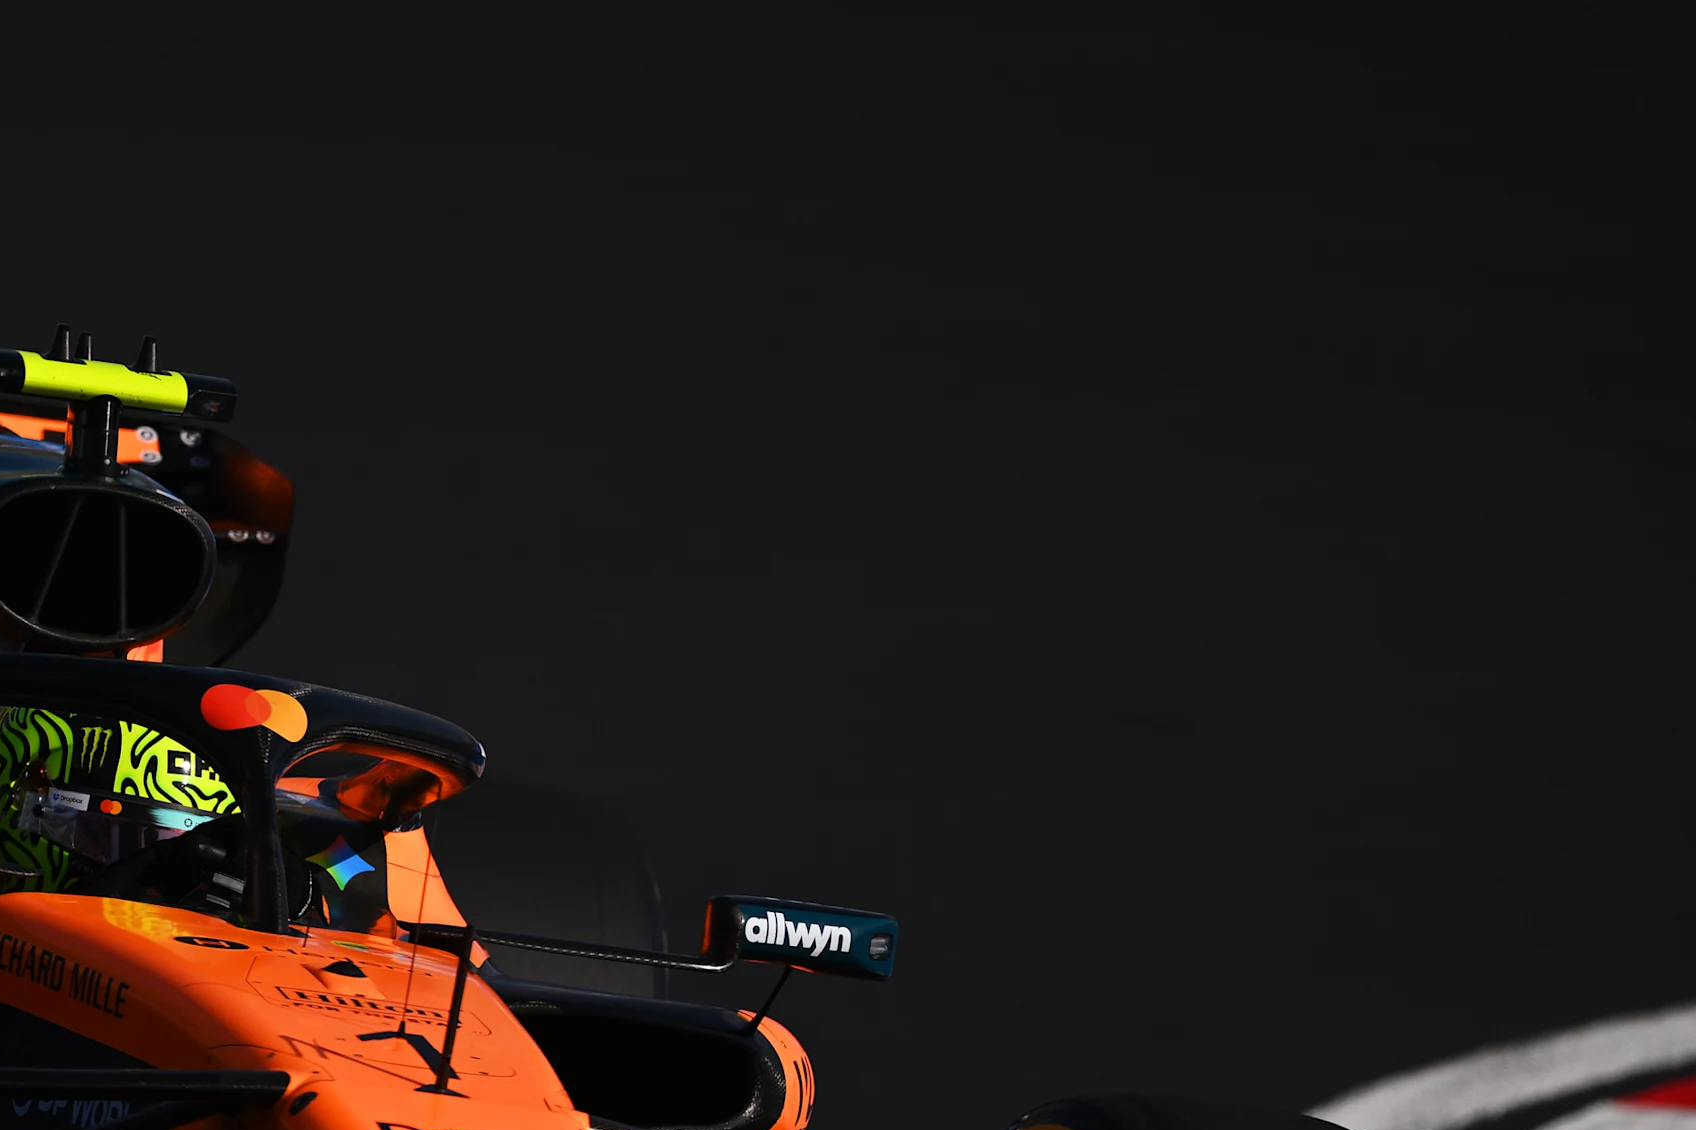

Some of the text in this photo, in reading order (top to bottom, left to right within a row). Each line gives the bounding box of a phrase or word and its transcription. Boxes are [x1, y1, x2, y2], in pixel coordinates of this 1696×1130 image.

[61, 796, 83, 806] Dropbox
[744, 910, 854, 956] allwyn
[70, 963, 130, 1019] MILLE
[295, 990, 444, 1020] Hilton
[290, 1001, 341, 1013] FOR
[351, 1009, 396, 1021] THE
